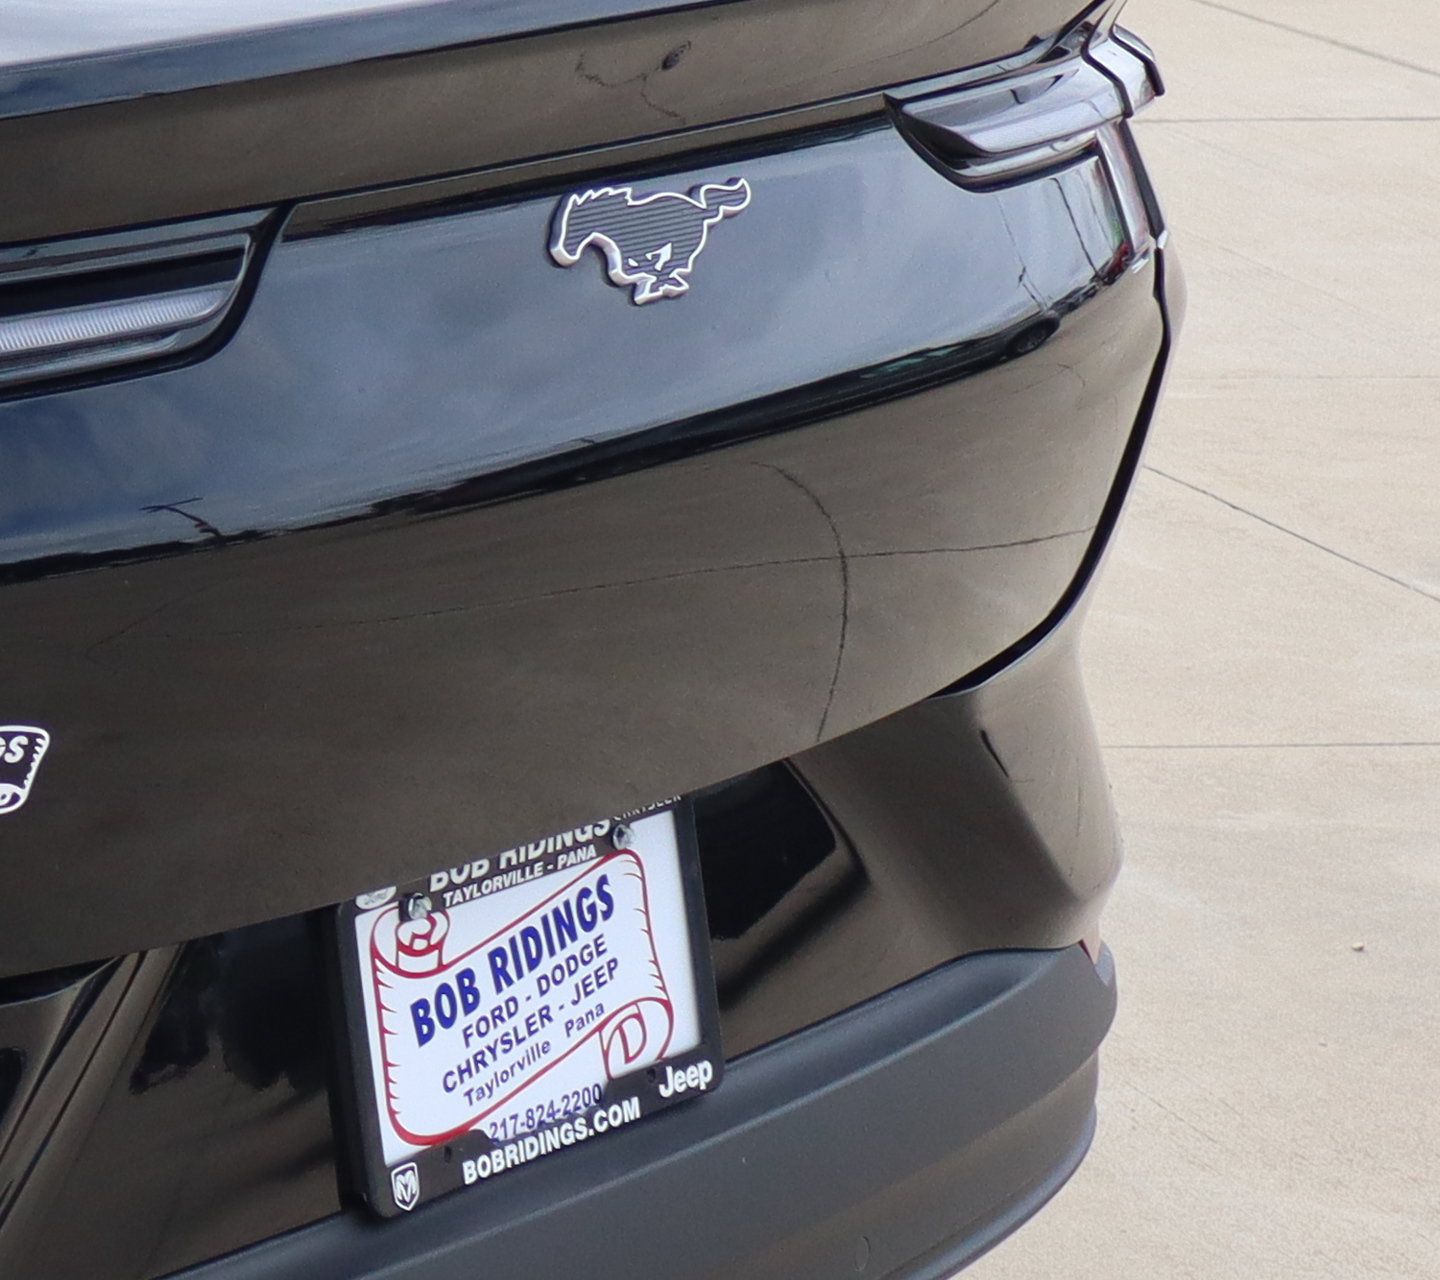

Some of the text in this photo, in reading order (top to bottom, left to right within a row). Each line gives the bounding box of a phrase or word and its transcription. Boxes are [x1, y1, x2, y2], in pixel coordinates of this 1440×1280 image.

[442, 861, 544, 908] TAYLORVILLE
[557, 844, 597, 870] PANA
[410, 873, 615, 1048] BOB RIDINGS
[461, 995, 520, 1049] FORD
[536, 933, 608, 997] DODGE
[442, 1004, 554, 1094] CHRYSLER
[570, 957, 619, 1007] JEEP
[463, 1002, 606, 1107] Taylorville Pana
[462, 1059, 714, 1186] BOBRIDINGS.COM Jeep
